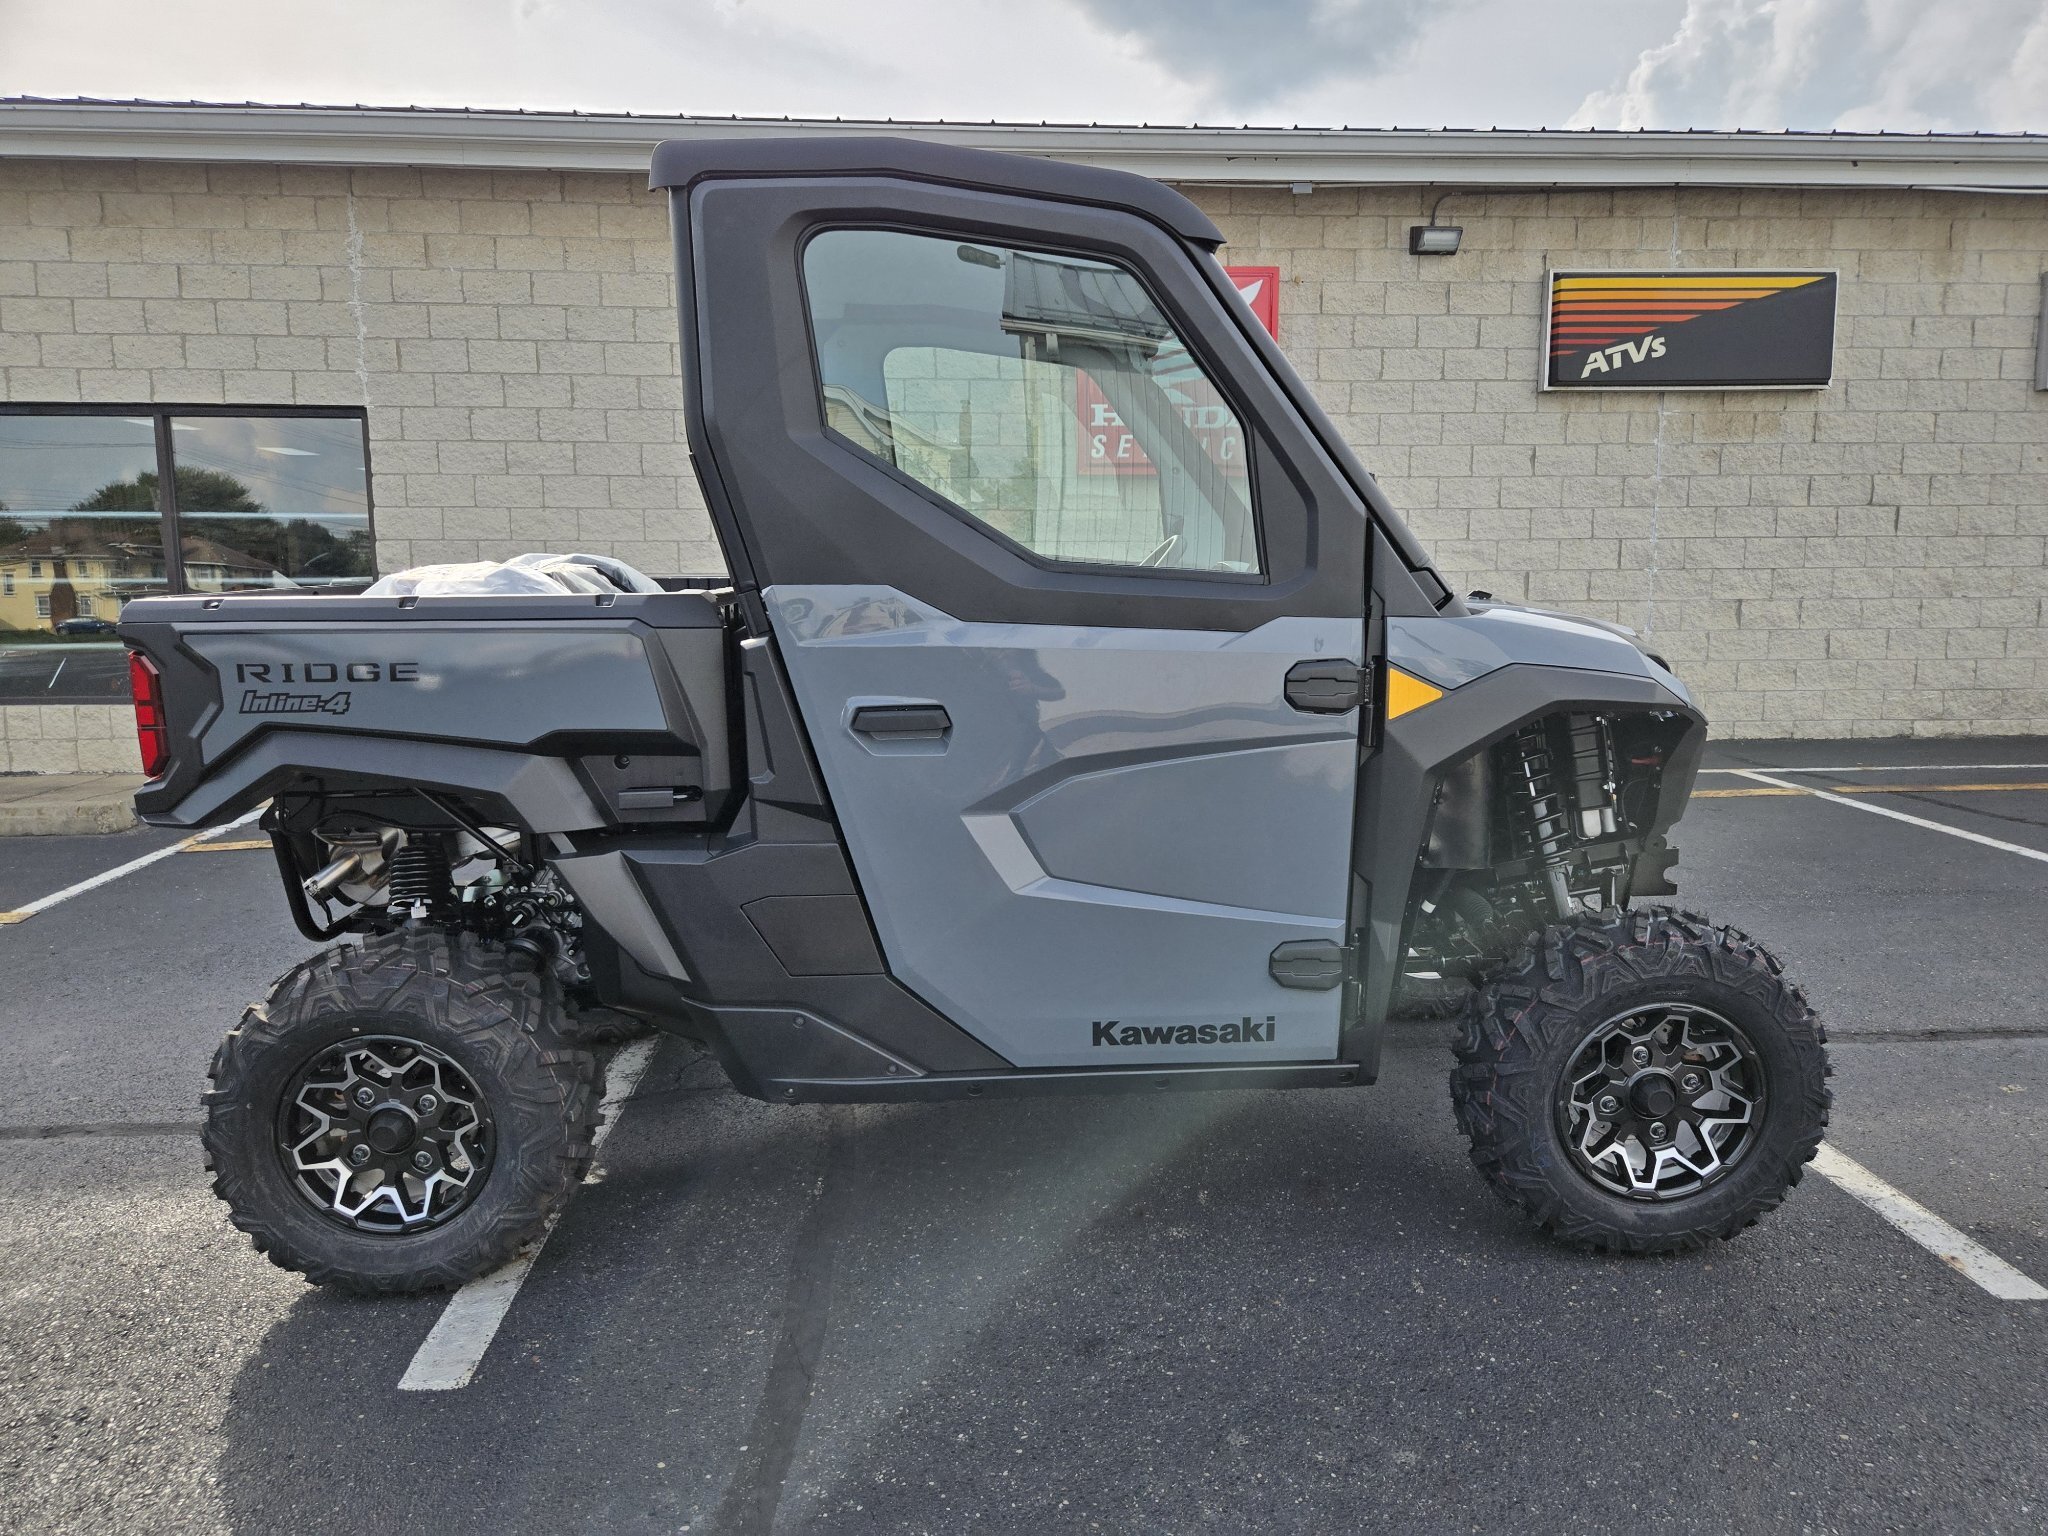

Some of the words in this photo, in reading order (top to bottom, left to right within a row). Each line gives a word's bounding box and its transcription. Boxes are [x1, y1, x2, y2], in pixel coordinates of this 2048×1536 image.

[1580, 335, 1667, 379] ATVs
[236, 662, 420, 683] RIDGE
[239, 689, 351, 715] Inline-4
[1092, 1015, 1276, 1047] Kawasaki
